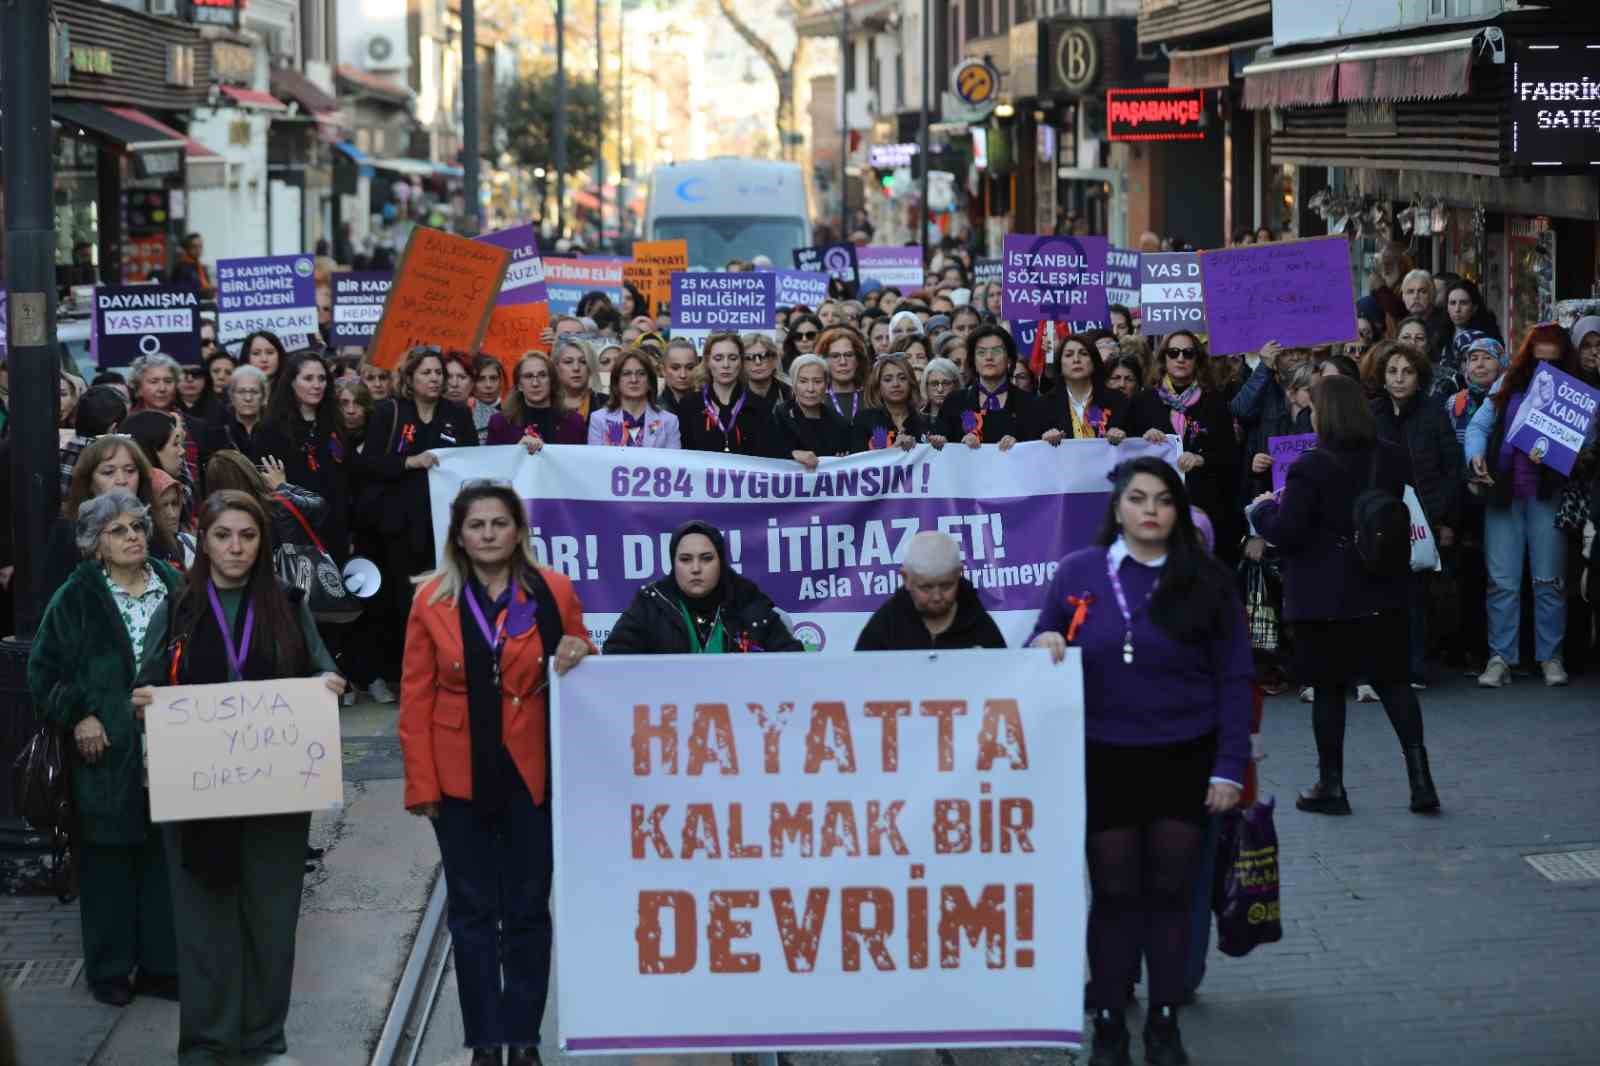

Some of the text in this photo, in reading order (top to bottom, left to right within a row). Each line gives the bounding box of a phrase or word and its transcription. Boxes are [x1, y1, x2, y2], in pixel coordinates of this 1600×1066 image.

[1112, 100, 1199, 127] PAŞABAHÇE
[1008, 251, 1088, 268] İSTANBUL
[238, 265, 292, 277] KASIM'DA
[1008, 269, 1104, 287] SÖZLEŞMESİ
[1147, 264, 1181, 277] YAS
[222, 276, 294, 292] BİRLİĞİMİZ
[681, 279, 696, 289] 25
[701, 279, 764, 289] KASIM'DA
[99, 293, 197, 308] DAYANIŞMA
[222, 291, 295, 308] BU DÜZENİ
[681, 291, 765, 306] BİRLİĞİMİZ
[1008, 290, 1088, 306] YAŞATIR!
[1162, 287, 1200, 301] YAŞ
[107, 314, 189, 330] YAŞATIR!
[681, 310, 765, 324] BU DÜZENİ
[1147, 306, 1205, 321] İSTİYO
[224, 315, 312, 332] SARSACAK!
[1557, 381, 1596, 413] ÖZGÜR
[1550, 400, 1589, 431] KADIN
[611, 465, 693, 498] 6284
[767, 516, 919, 573] İTİRAZ
[799, 576, 851, 600] Asla
[167, 693, 294, 724] SUSMA
[224, 722, 299, 755] YÜRÜ
[631, 699, 1029, 776] HAYATTA
[192, 763, 273, 792] DİREN
[631, 782, 1035, 859] KALMAK BİR
[635, 863, 1035, 975] DEVRİM!
